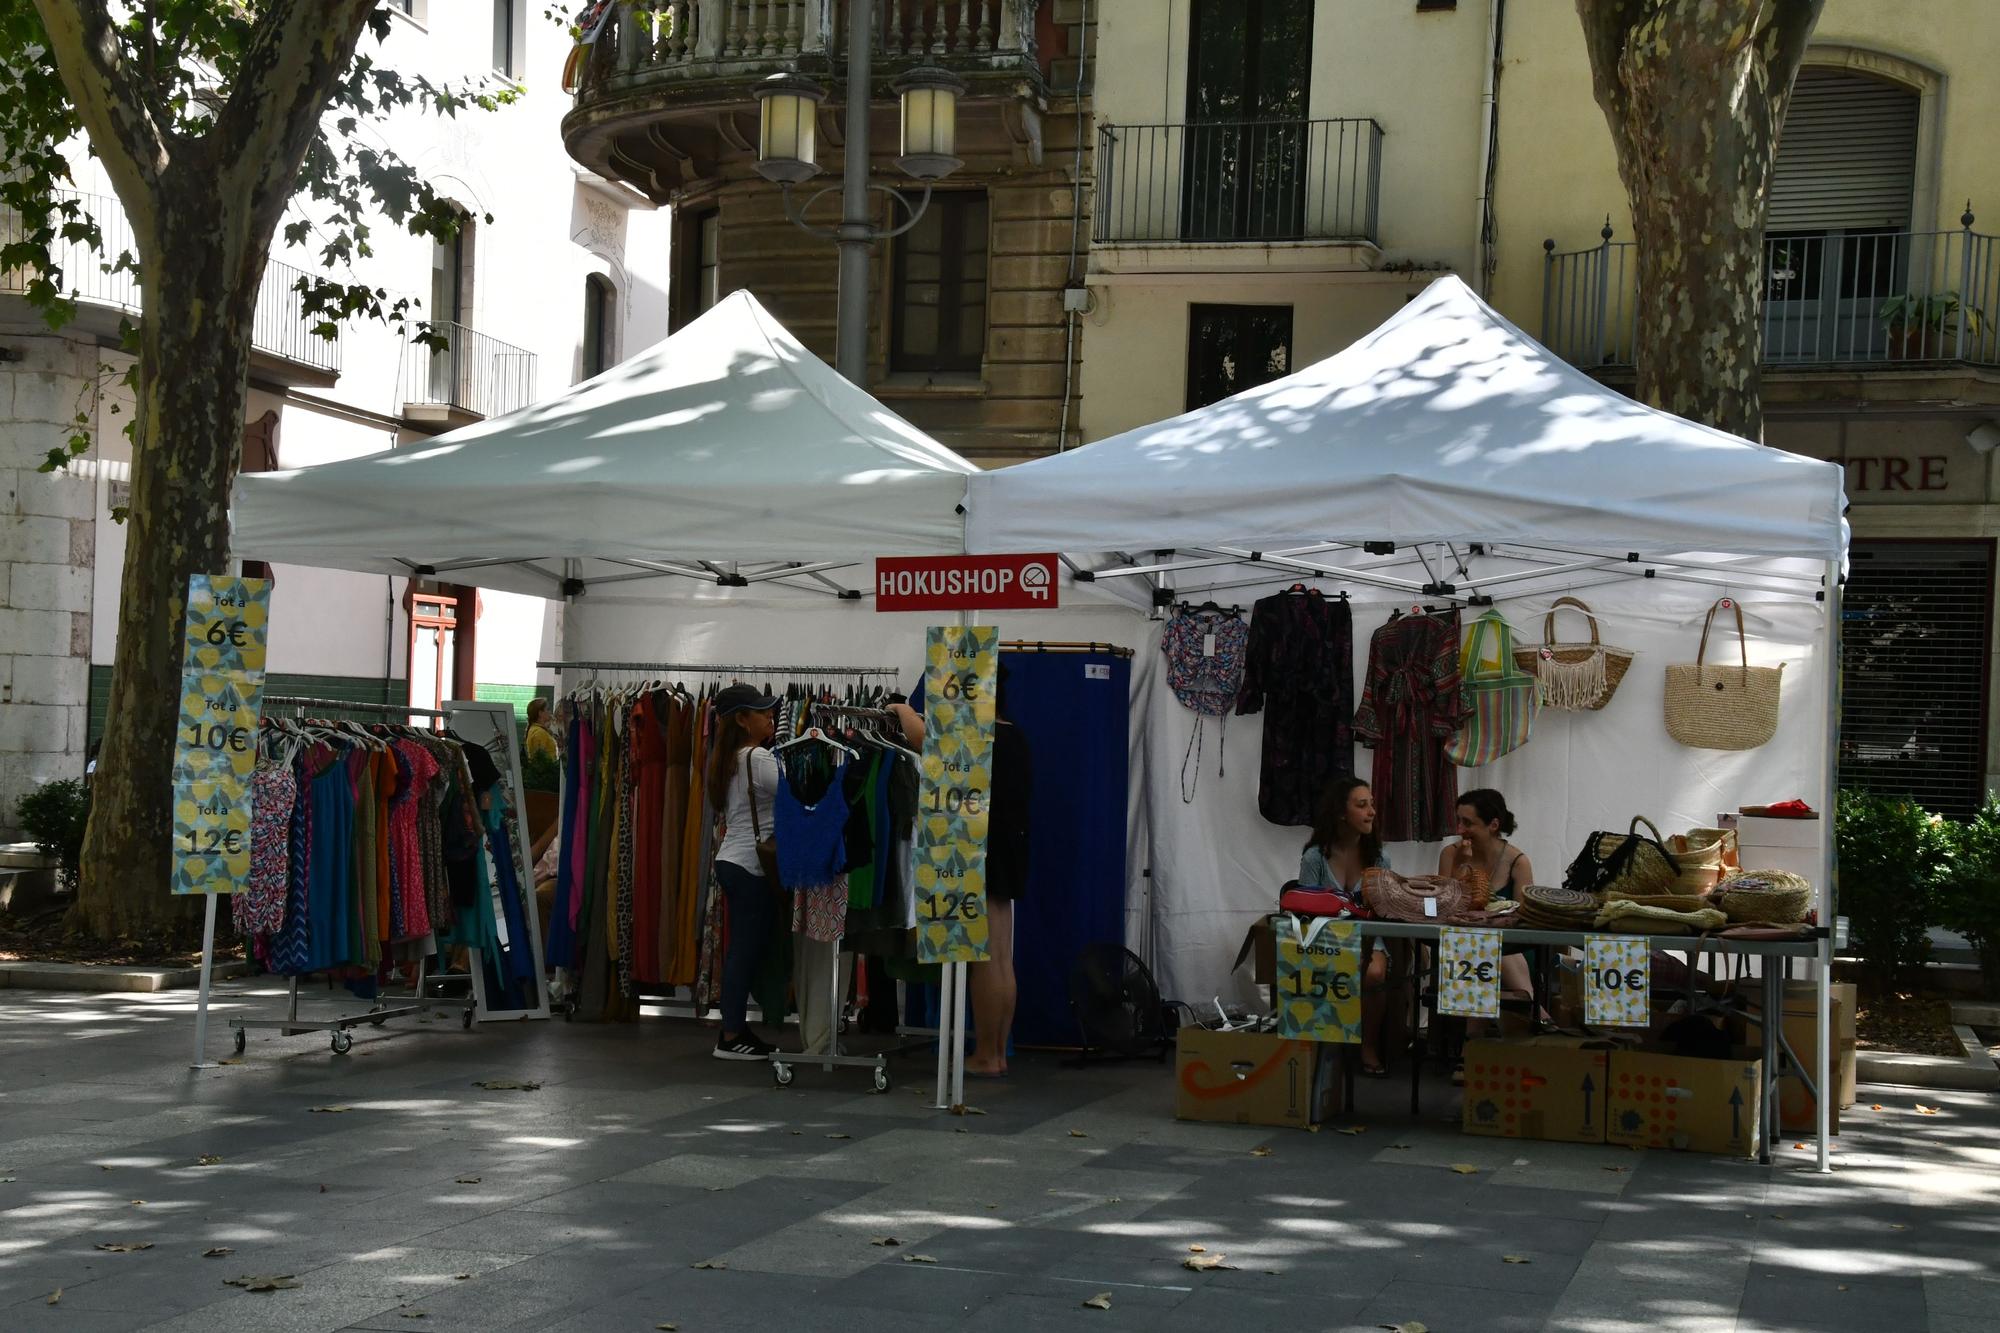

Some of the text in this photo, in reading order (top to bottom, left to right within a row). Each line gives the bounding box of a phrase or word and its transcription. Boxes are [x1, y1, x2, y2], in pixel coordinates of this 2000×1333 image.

[1830, 455, 1949, 491] TRE
[879, 568, 1014, 596] HOKUSHOP
[213, 595, 246, 609] Tot a
[206, 620, 248, 647] 6€
[947, 648, 977, 660] Tot a
[942, 673, 979, 701] 6€
[205, 699, 238, 713] Tot a
[188, 723, 248, 752] 10€
[942, 761, 971, 773] Tot a
[197, 804, 229, 817] Tot a
[929, 786, 982, 816] 10€
[184, 828, 243, 856] 12€
[935, 867, 964, 879] Tot a
[923, 891, 979, 922] 12€
[1447, 959, 1494, 983] 12€
[1591, 967, 1645, 991] 10€
[1288, 970, 1352, 1000] 15€
